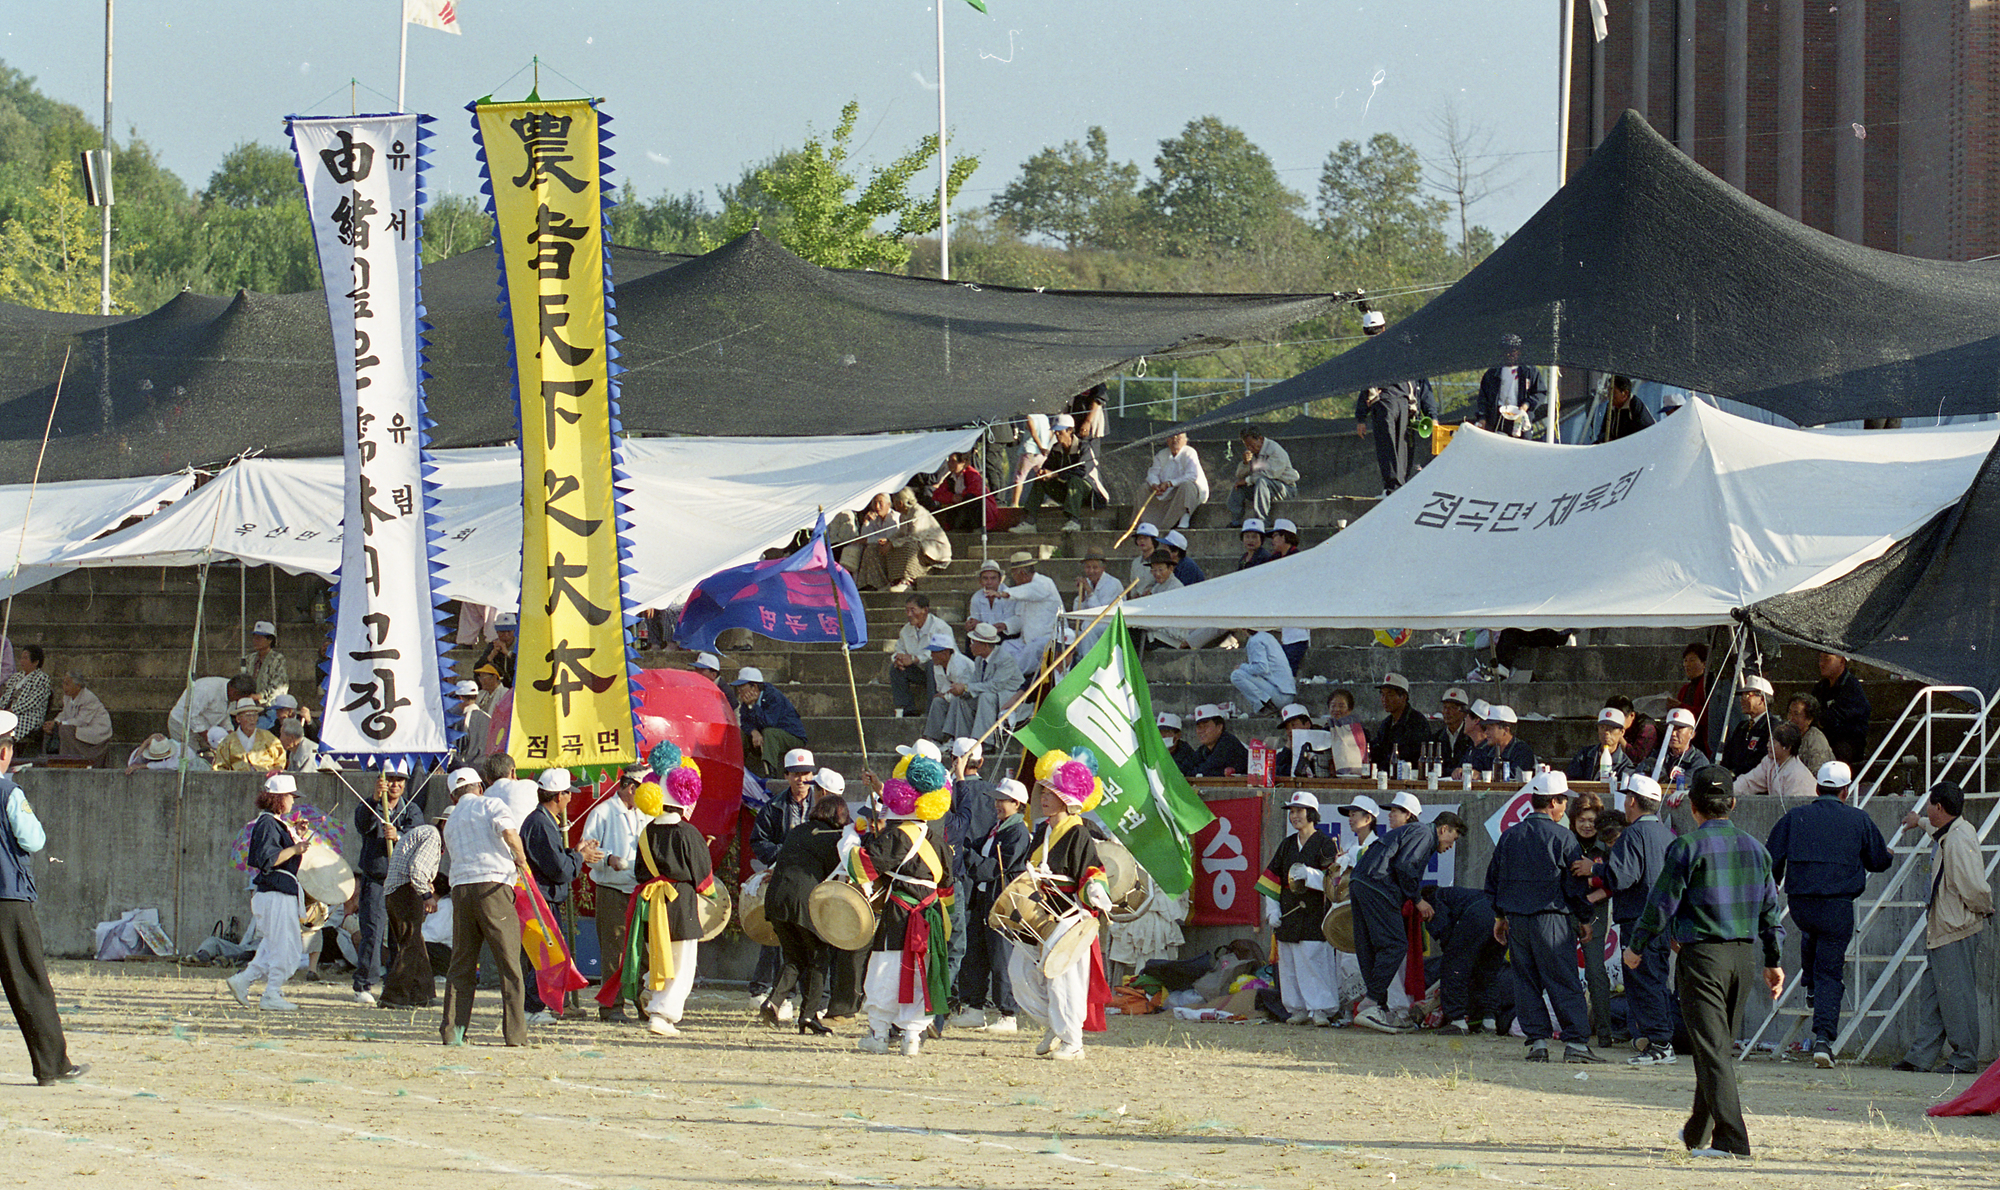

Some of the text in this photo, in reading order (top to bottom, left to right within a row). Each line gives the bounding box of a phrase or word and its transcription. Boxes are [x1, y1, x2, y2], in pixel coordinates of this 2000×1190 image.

[385, 140, 414, 516] 유서 유림
[1414, 467, 1644, 533] 점곡면 체육회
[339, 612, 411, 740] 고장
[526, 728, 621, 760] 점곡면
[1100, 776, 1147, 835] 곡면
[1202, 816, 1248, 910] 승
